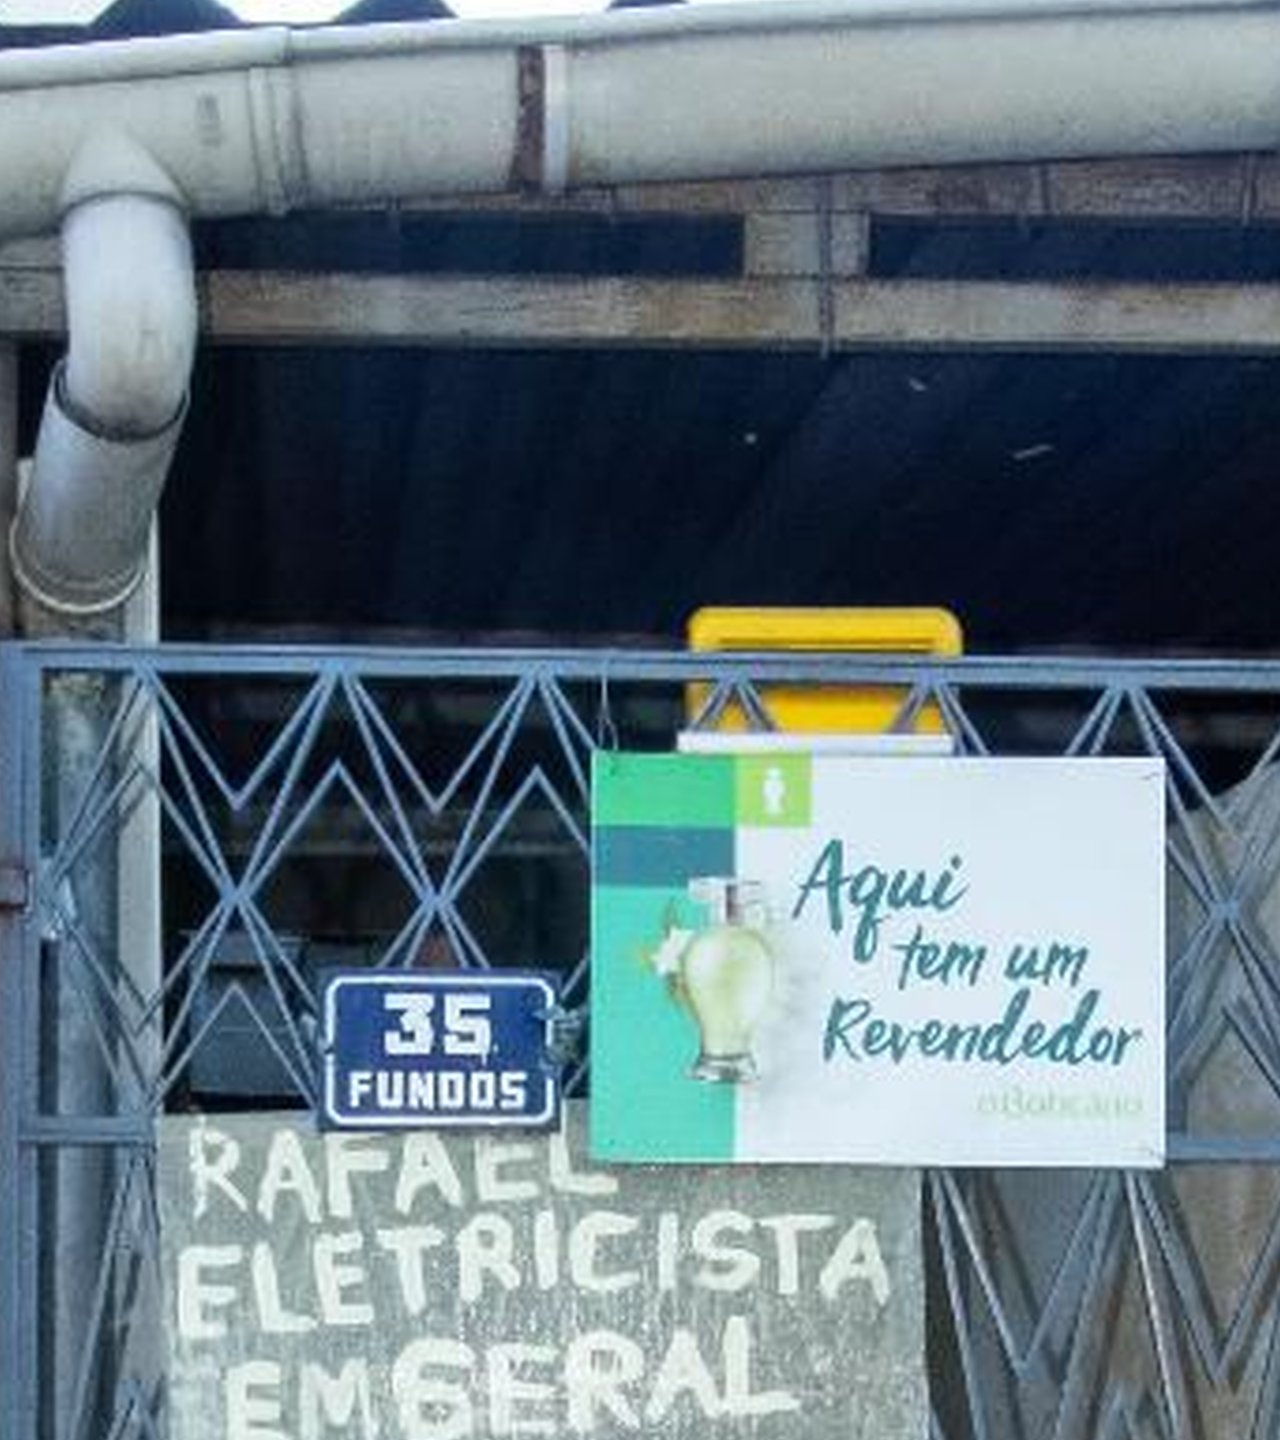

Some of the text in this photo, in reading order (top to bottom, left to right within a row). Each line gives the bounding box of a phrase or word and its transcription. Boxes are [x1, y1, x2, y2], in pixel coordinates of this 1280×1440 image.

[792, 839, 967, 964] Aqui
[890, 925, 1090, 991] tem um
[382, 992, 492, 1064] 35
[822, 988, 1144, 1067] Revendedor
[348, 1071, 528, 1110] FUNDOS
[188, 1126, 620, 1224] RAFAEL
[176, 1209, 892, 1340] ELETRICISTA
